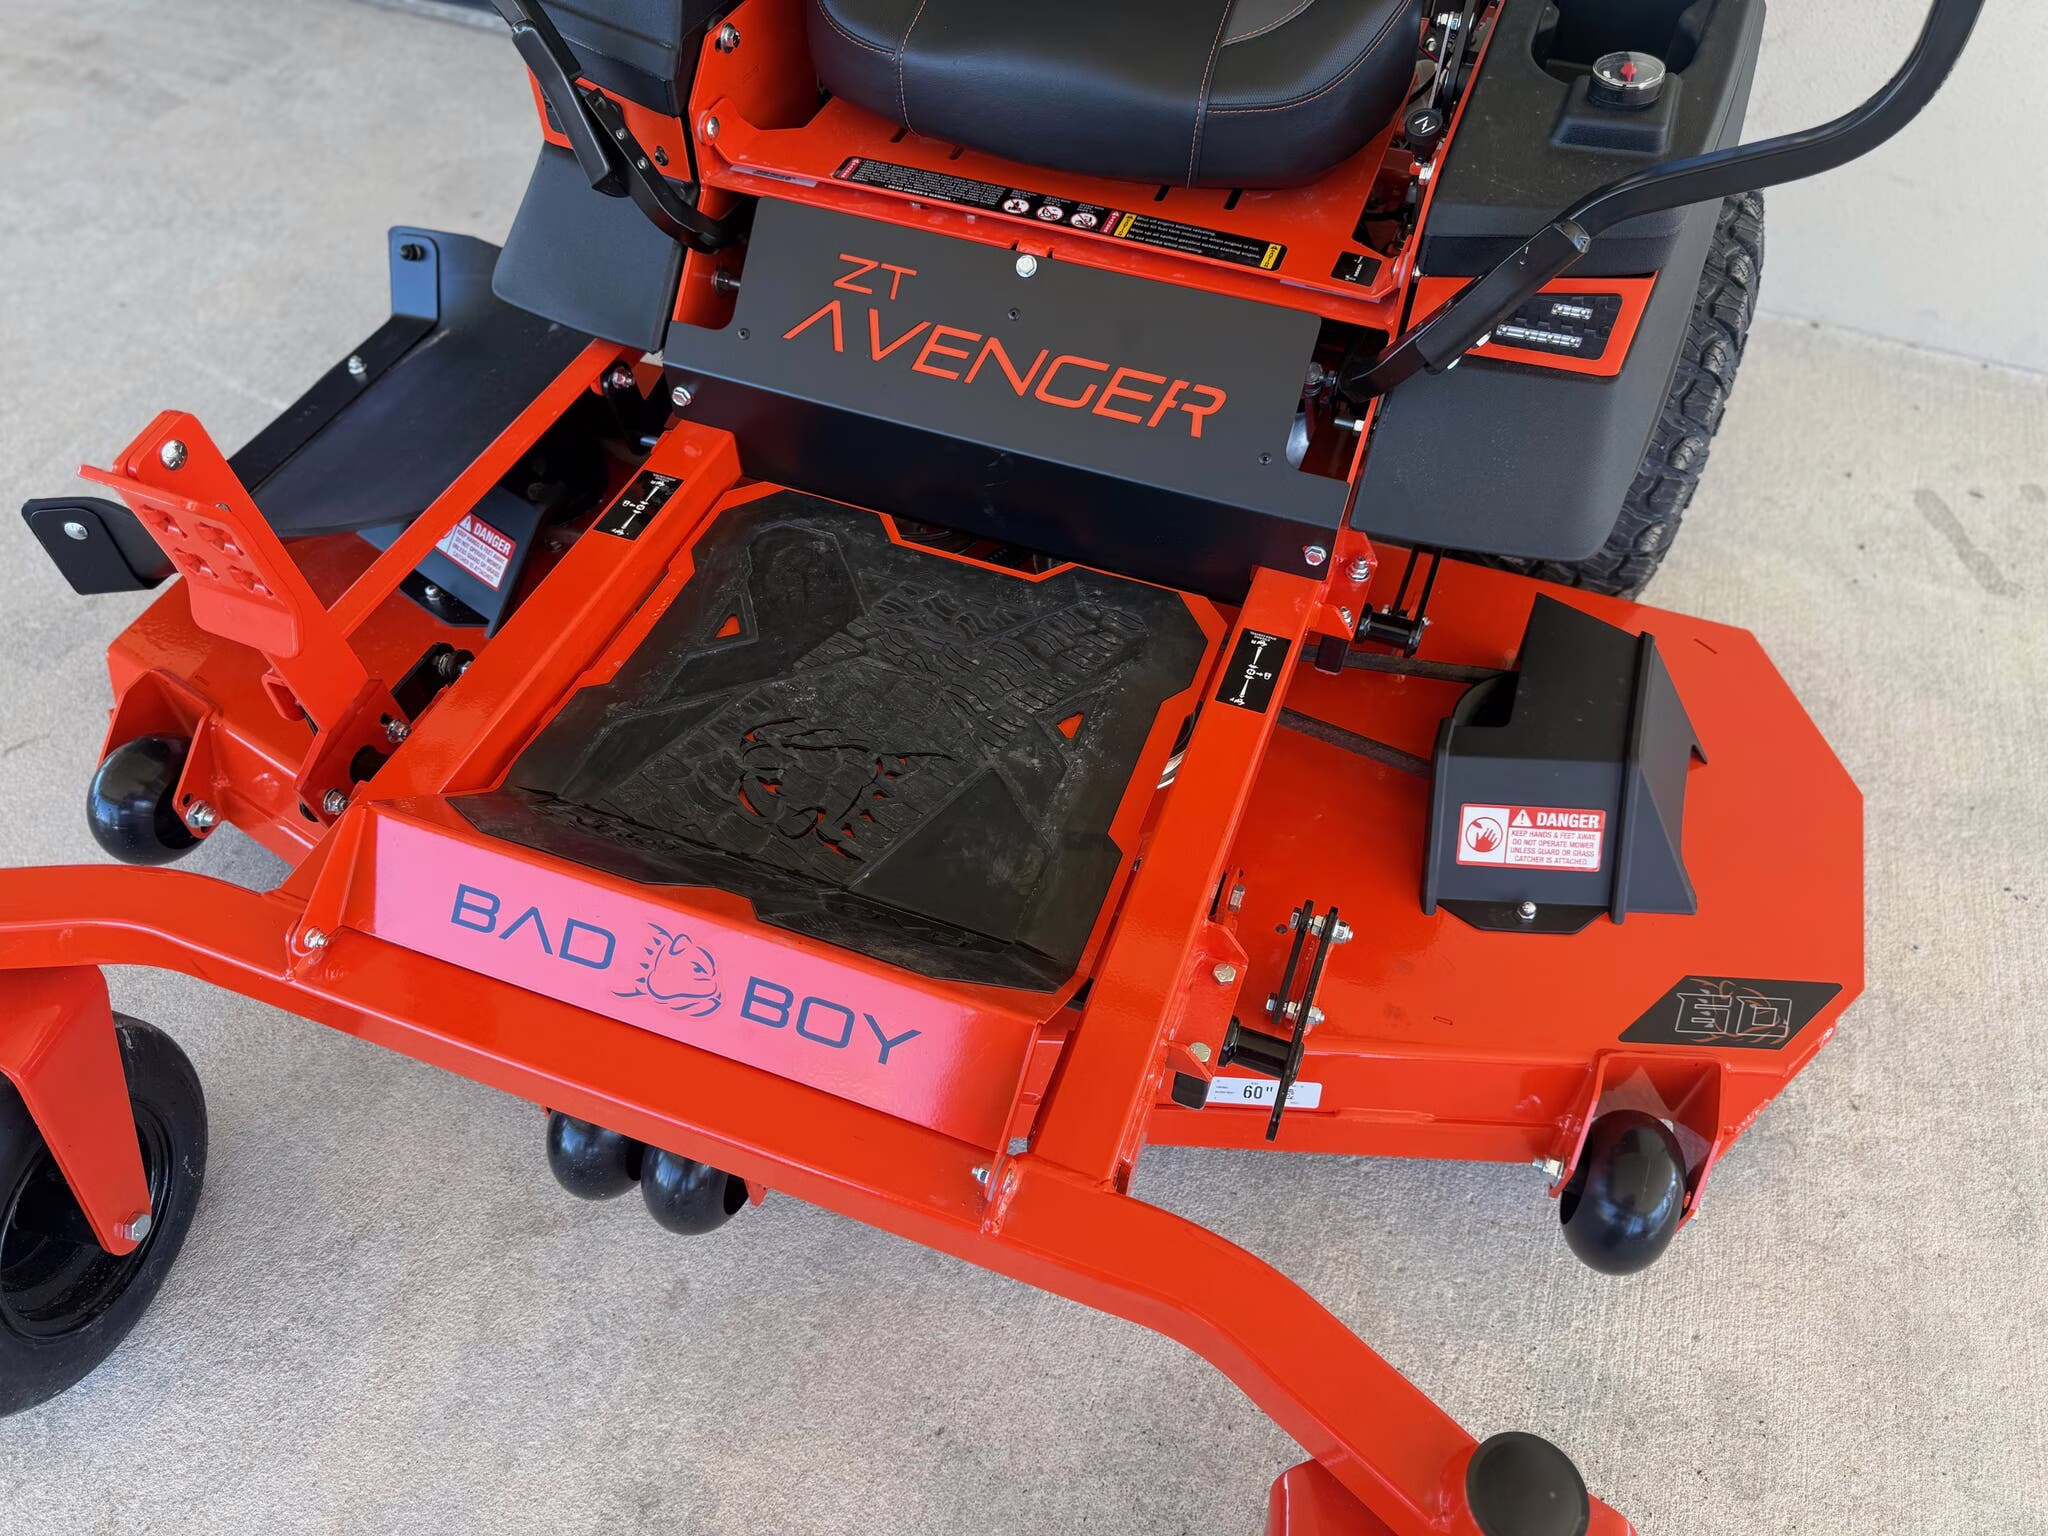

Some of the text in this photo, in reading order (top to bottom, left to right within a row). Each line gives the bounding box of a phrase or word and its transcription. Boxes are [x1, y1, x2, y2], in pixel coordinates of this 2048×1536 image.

[833, 253, 917, 300] ZT
[782, 300, 1227, 438] AVENGER
[473, 522, 512, 556] DANGER
[1536, 811, 1600, 829] DANGER
[1510, 847, 1536, 855] UNLESS
[1537, 848, 1560, 856] GUARD
[1538, 840, 1567, 848] OPERATE
[1569, 841, 1594, 849] MOWER
[1514, 855, 1544, 863] CATCHER
[1546, 856, 1552, 864] IS
[450, 883, 922, 1065] BAD BOY
[1243, 1085, 1273, 1099] 60"
